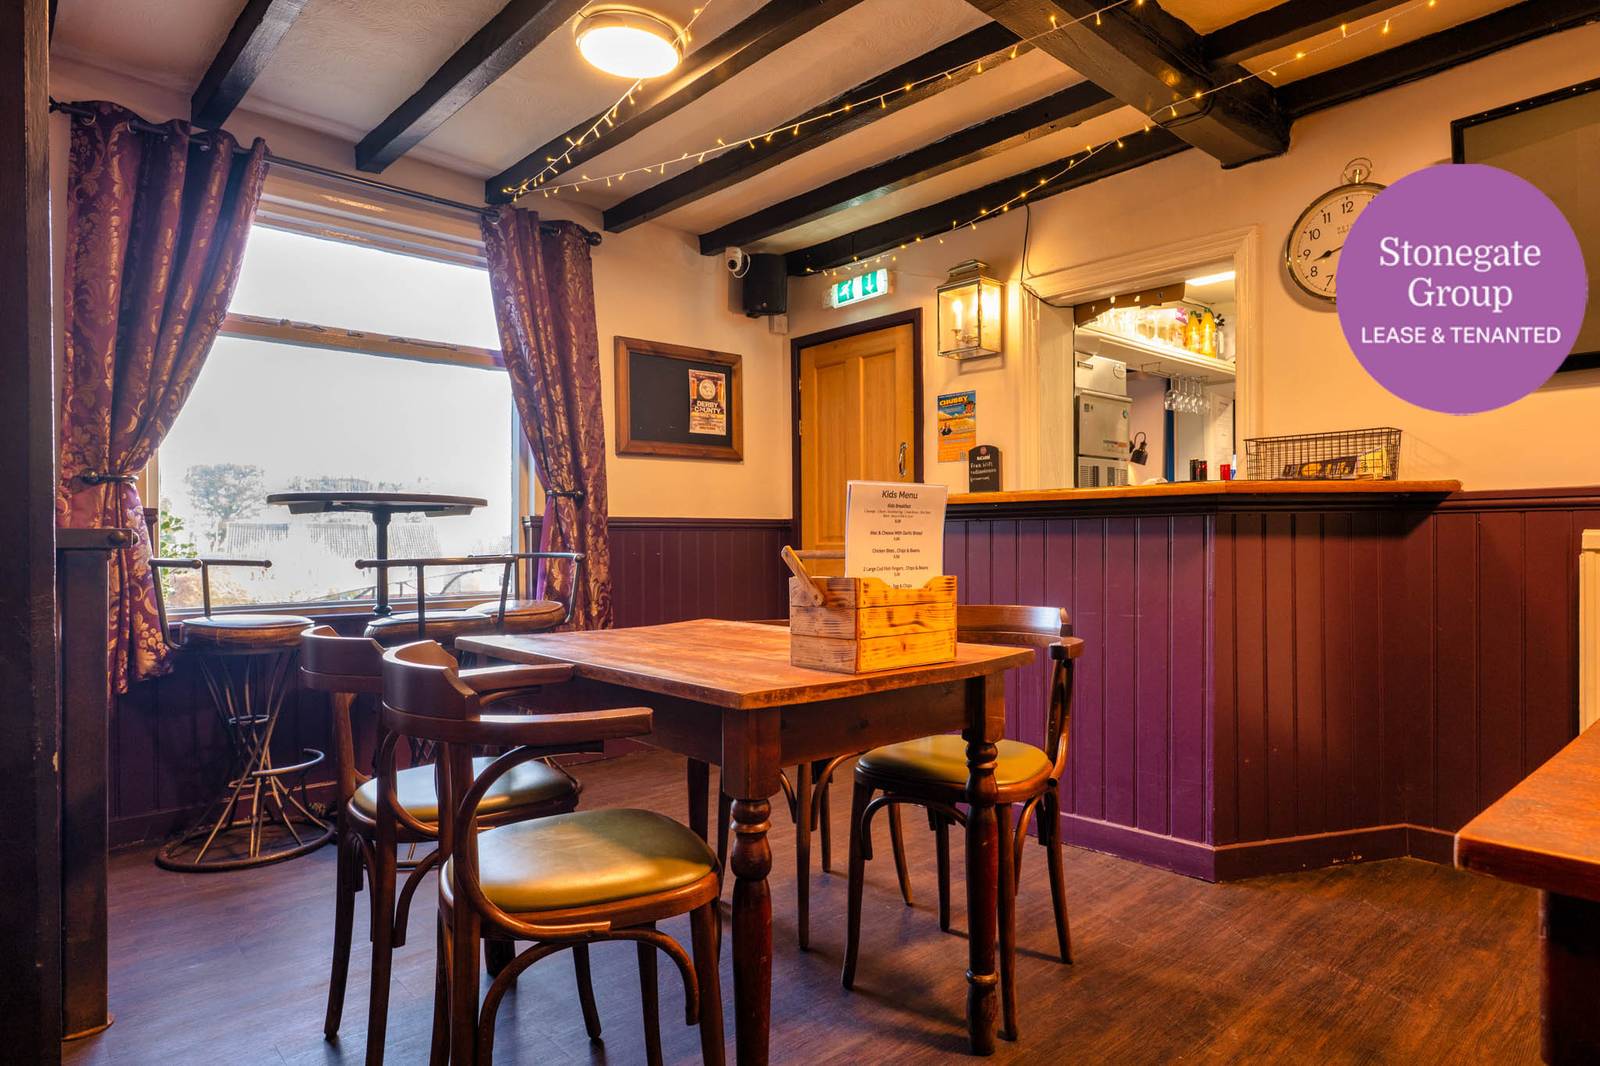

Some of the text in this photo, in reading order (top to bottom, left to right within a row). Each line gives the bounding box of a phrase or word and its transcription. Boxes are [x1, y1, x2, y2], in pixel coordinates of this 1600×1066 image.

[1342, 201, 1354, 214] 12
[1323, 212, 1331, 224] 11
[1309, 228, 1321, 241] 10
[1303, 249, 1311, 261] 9
[1310, 266, 1318, 277] 8
[1326, 274, 1334, 287] 7
[696, 400, 719, 408] DERBY
[694, 406, 721, 415] COUNTY
[881, 490, 918, 499] Kids Menu
